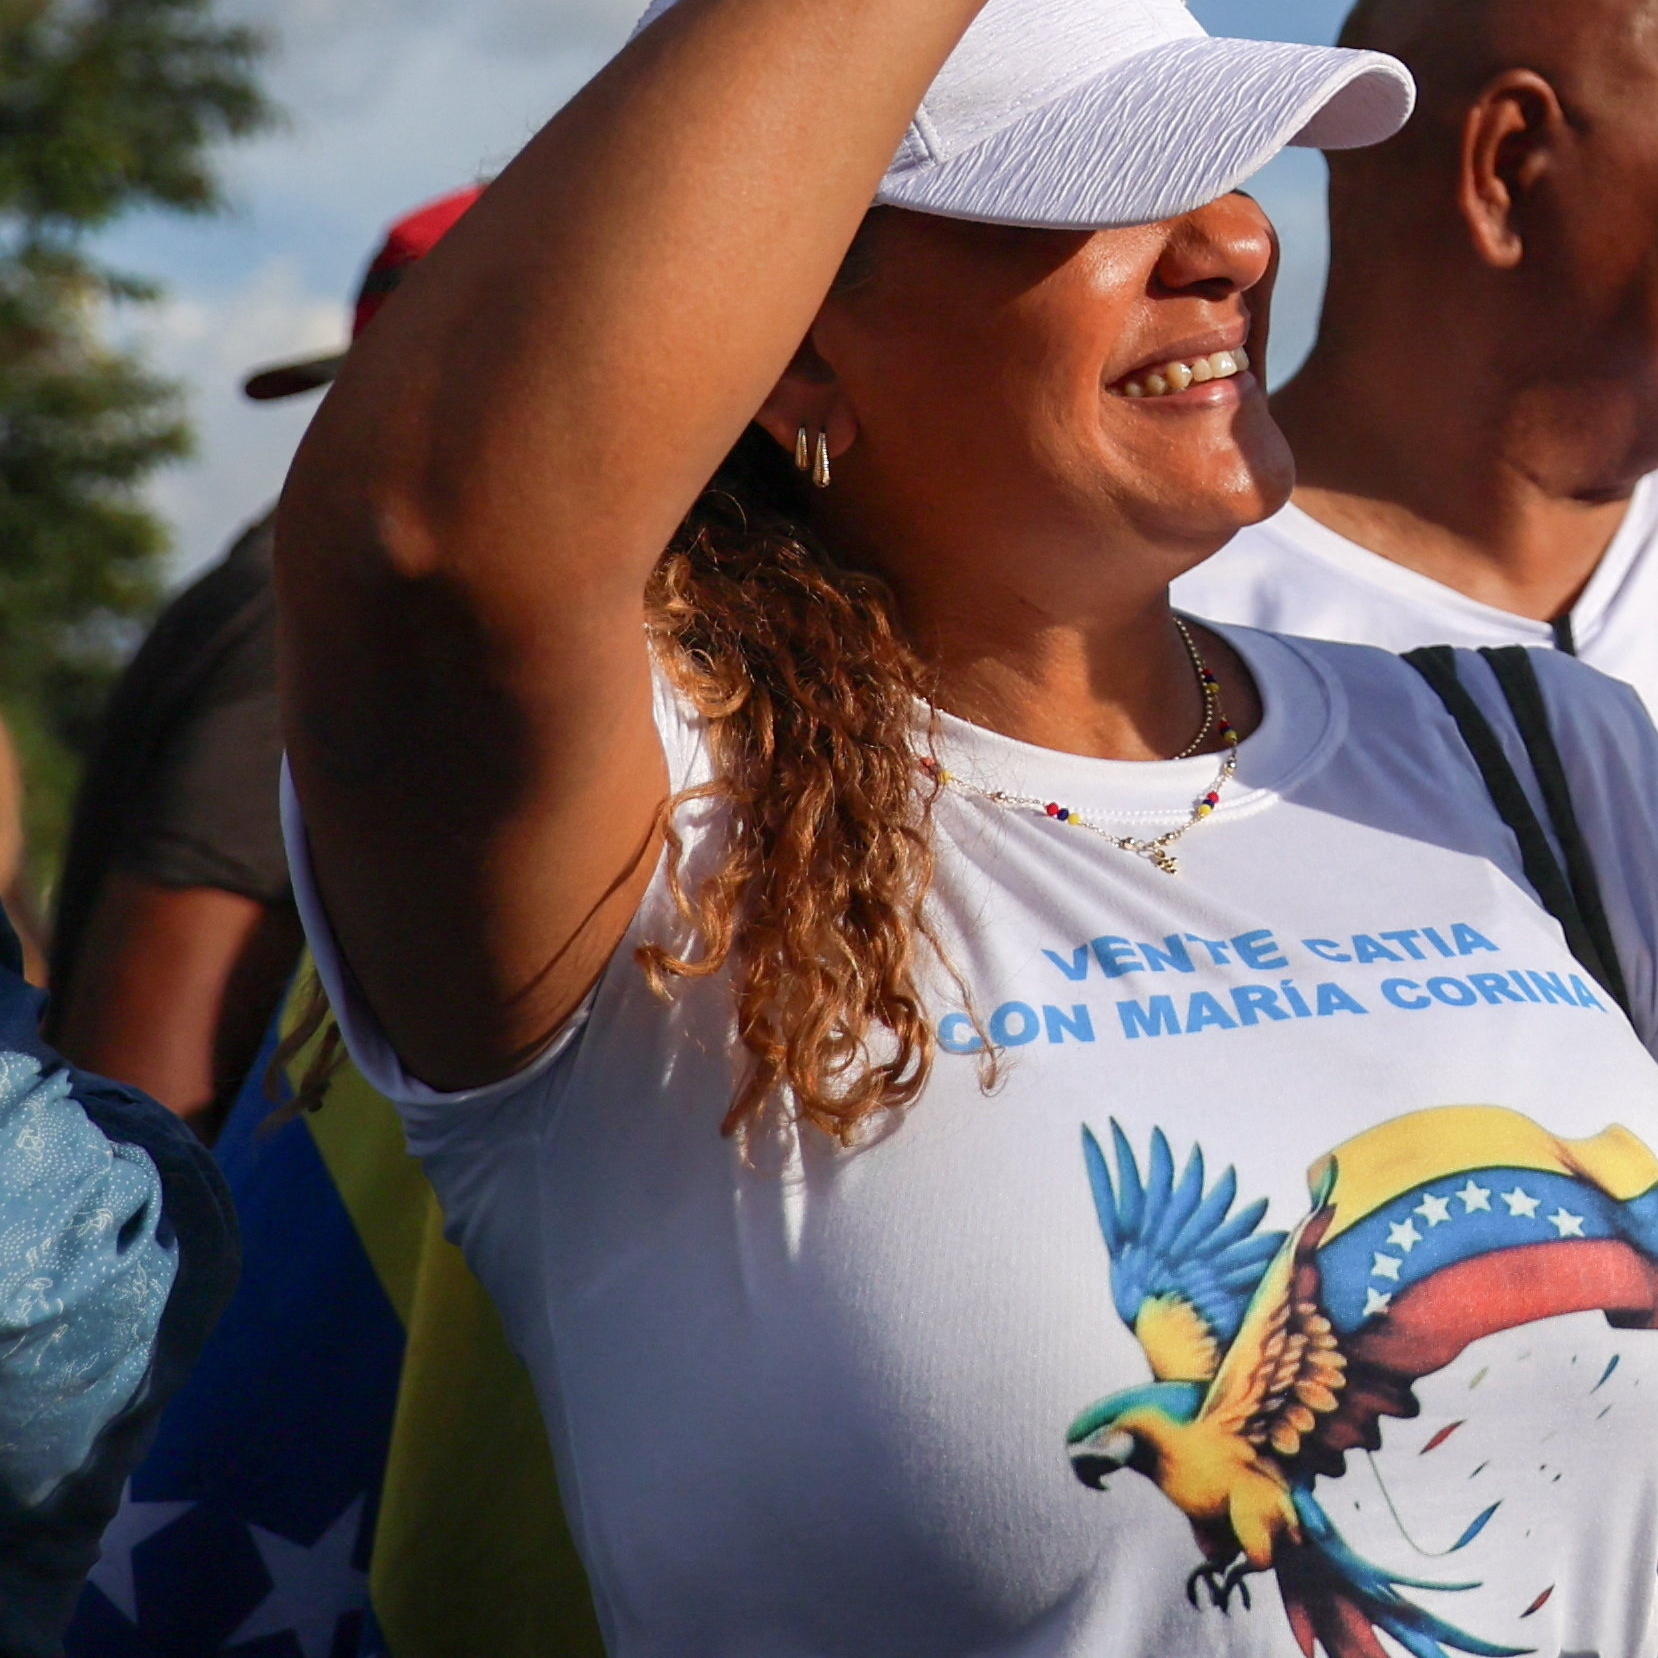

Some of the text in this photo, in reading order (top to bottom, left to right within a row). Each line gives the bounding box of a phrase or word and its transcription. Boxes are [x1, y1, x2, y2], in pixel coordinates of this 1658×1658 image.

[1041, 922, 1501, 981] VENTE CATIA
[937, 1001, 1096, 1053] CON
[1380, 969, 1609, 1013] CORINA
